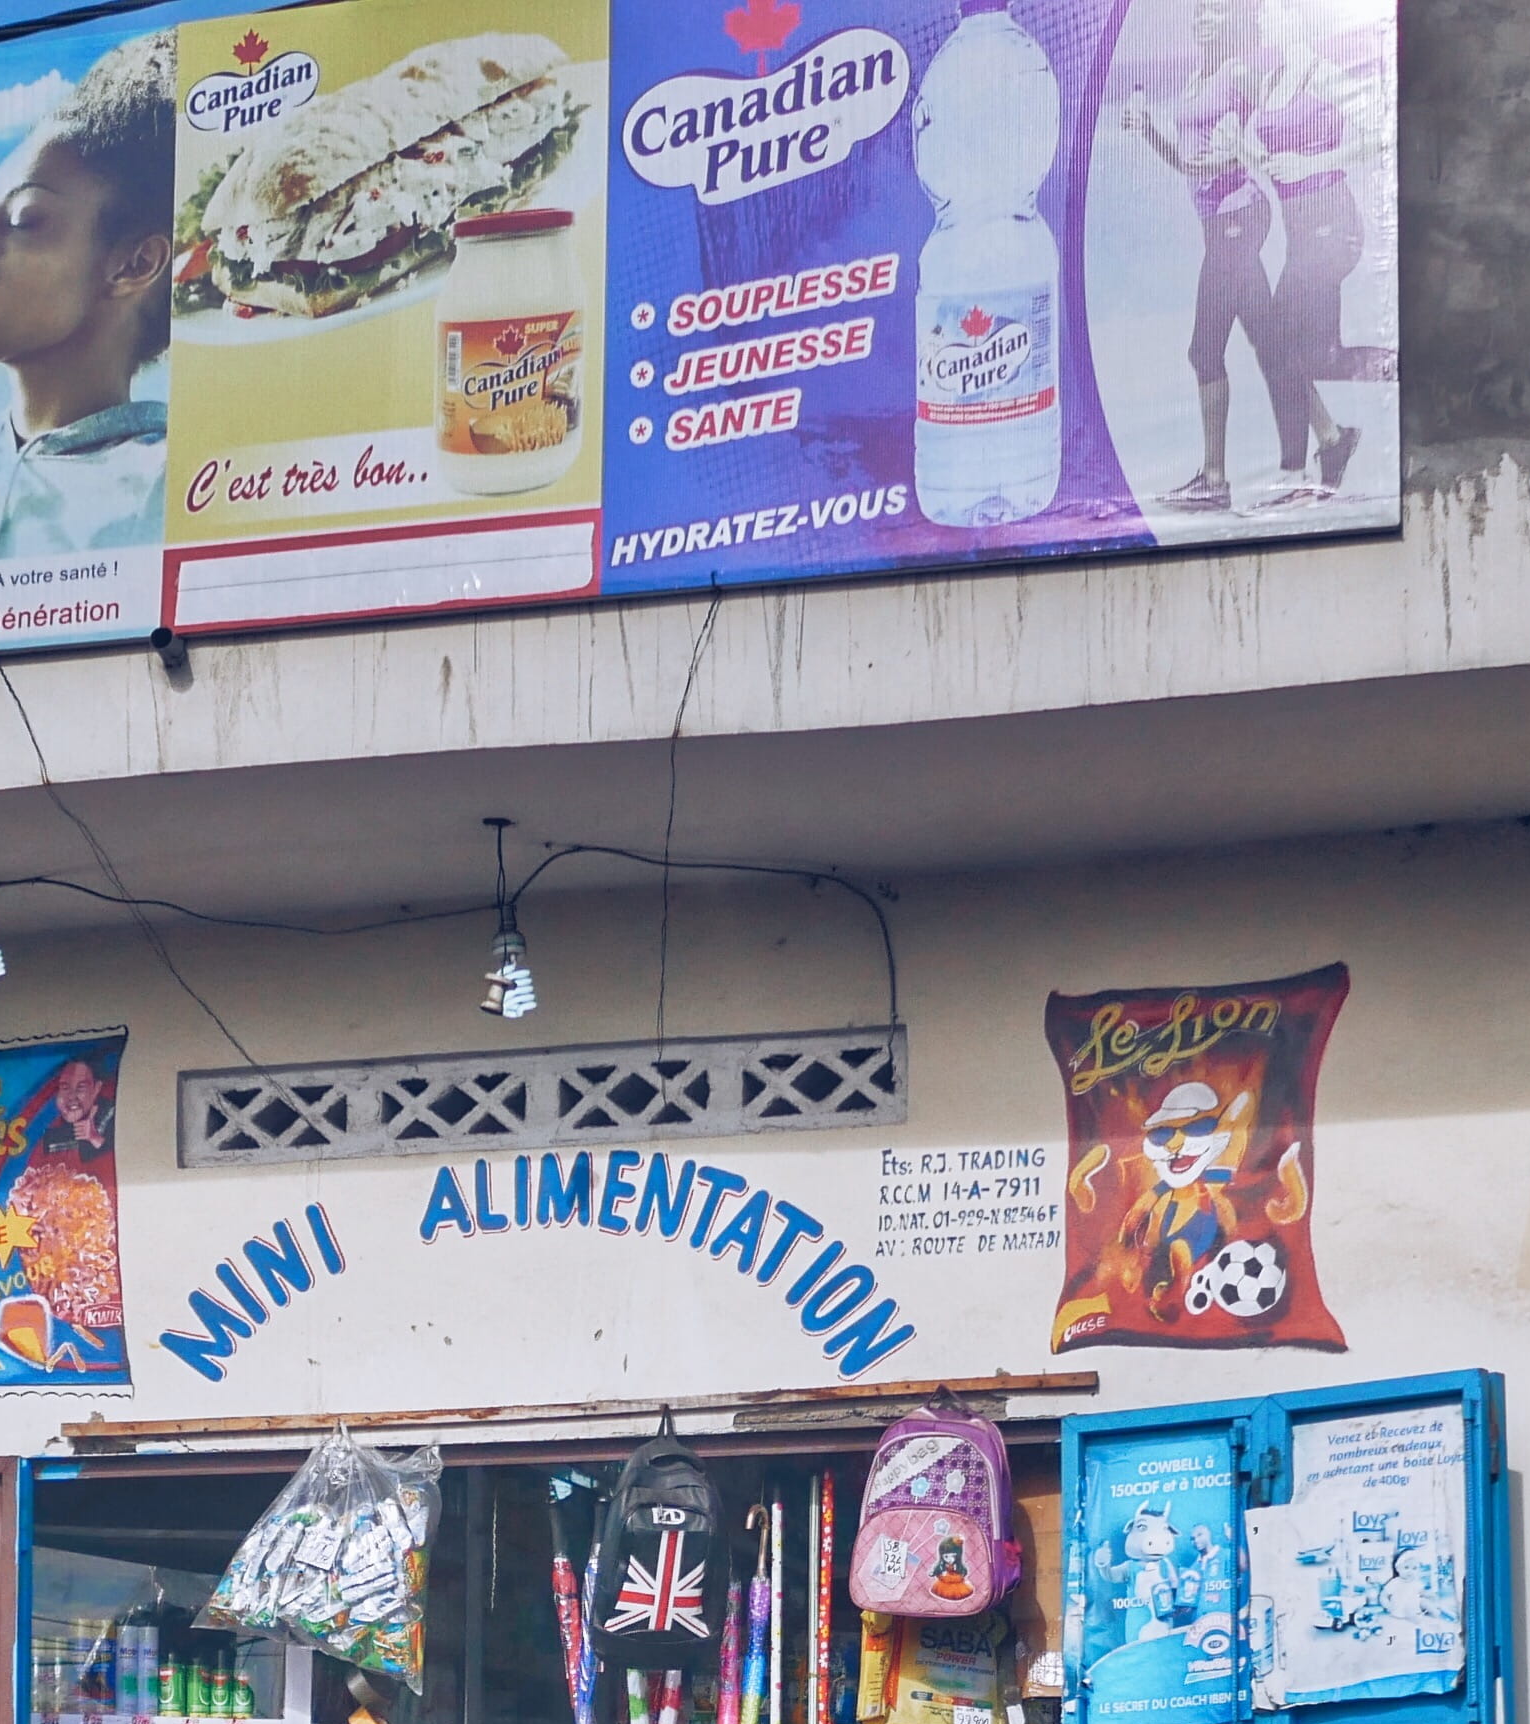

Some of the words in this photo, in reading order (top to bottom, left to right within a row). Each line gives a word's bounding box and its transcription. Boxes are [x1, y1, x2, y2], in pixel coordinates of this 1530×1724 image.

[187, 62, 314, 117] Canadian
[630, 43, 897, 158] Canadian
[221, 98, 282, 133] Pure
[701, 119, 830, 194] Pure
[670, 258, 896, 331] SOUPLESSE
[668, 324, 870, 391] JEUNESSE
[936, 331, 1028, 380] Canadian
[464, 347, 562, 396] Canadian
[961, 363, 1008, 394] Pure
[490, 380, 538, 412] Pure
[670, 396, 795, 446] SANTE
[186, 460, 272, 513] C'est
[283, 458, 339, 494] très
[611, 486, 908, 567] HYDRATEZ-VOUS
[10, 569, 54, 586] votre
[59, 563, 106, 582] santé
[958, 1148, 1046, 1171] TRADING
[911, 1236, 966, 1256] ROUTE
[978, 1234, 997, 1252] DE
[1002, 1230, 1061, 1251] MATADI
[159, 1203, 347, 1382] MINI
[420, 1150, 916, 1381] ALIMENTATION
[1328, 1433, 1361, 1445] Venez
[1380, 1425, 1425, 1438] Recevez
[1429, 1421, 1443, 1432] de
[907, 1439, 939, 1464] bag
[1329, 1446, 1387, 1462] nombreux
[1391, 1439, 1442, 1454] cadeaux
[1138, 1457, 1202, 1476] COWBELL
[1323, 1463, 1374, 1479] achetant
[1378, 1460, 1398, 1471] une
[1110, 1480, 1160, 1499] 150CDF
[1163, 1479, 1176, 1493] et
[1363, 1477, 1377, 1488] de
[1397, 1529, 1428, 1549] Loya
[920, 1625, 992, 1658] SABA
[1416, 1628, 1455, 1654] Loya
[936, 1652, 977, 1665] POWER
[1099, 1703, 1110, 1714] LE
[1113, 1700, 1149, 1713] SECRET
[1152, 1698, 1168, 1710] DU
[1170, 1694, 1207, 1708] COACH
